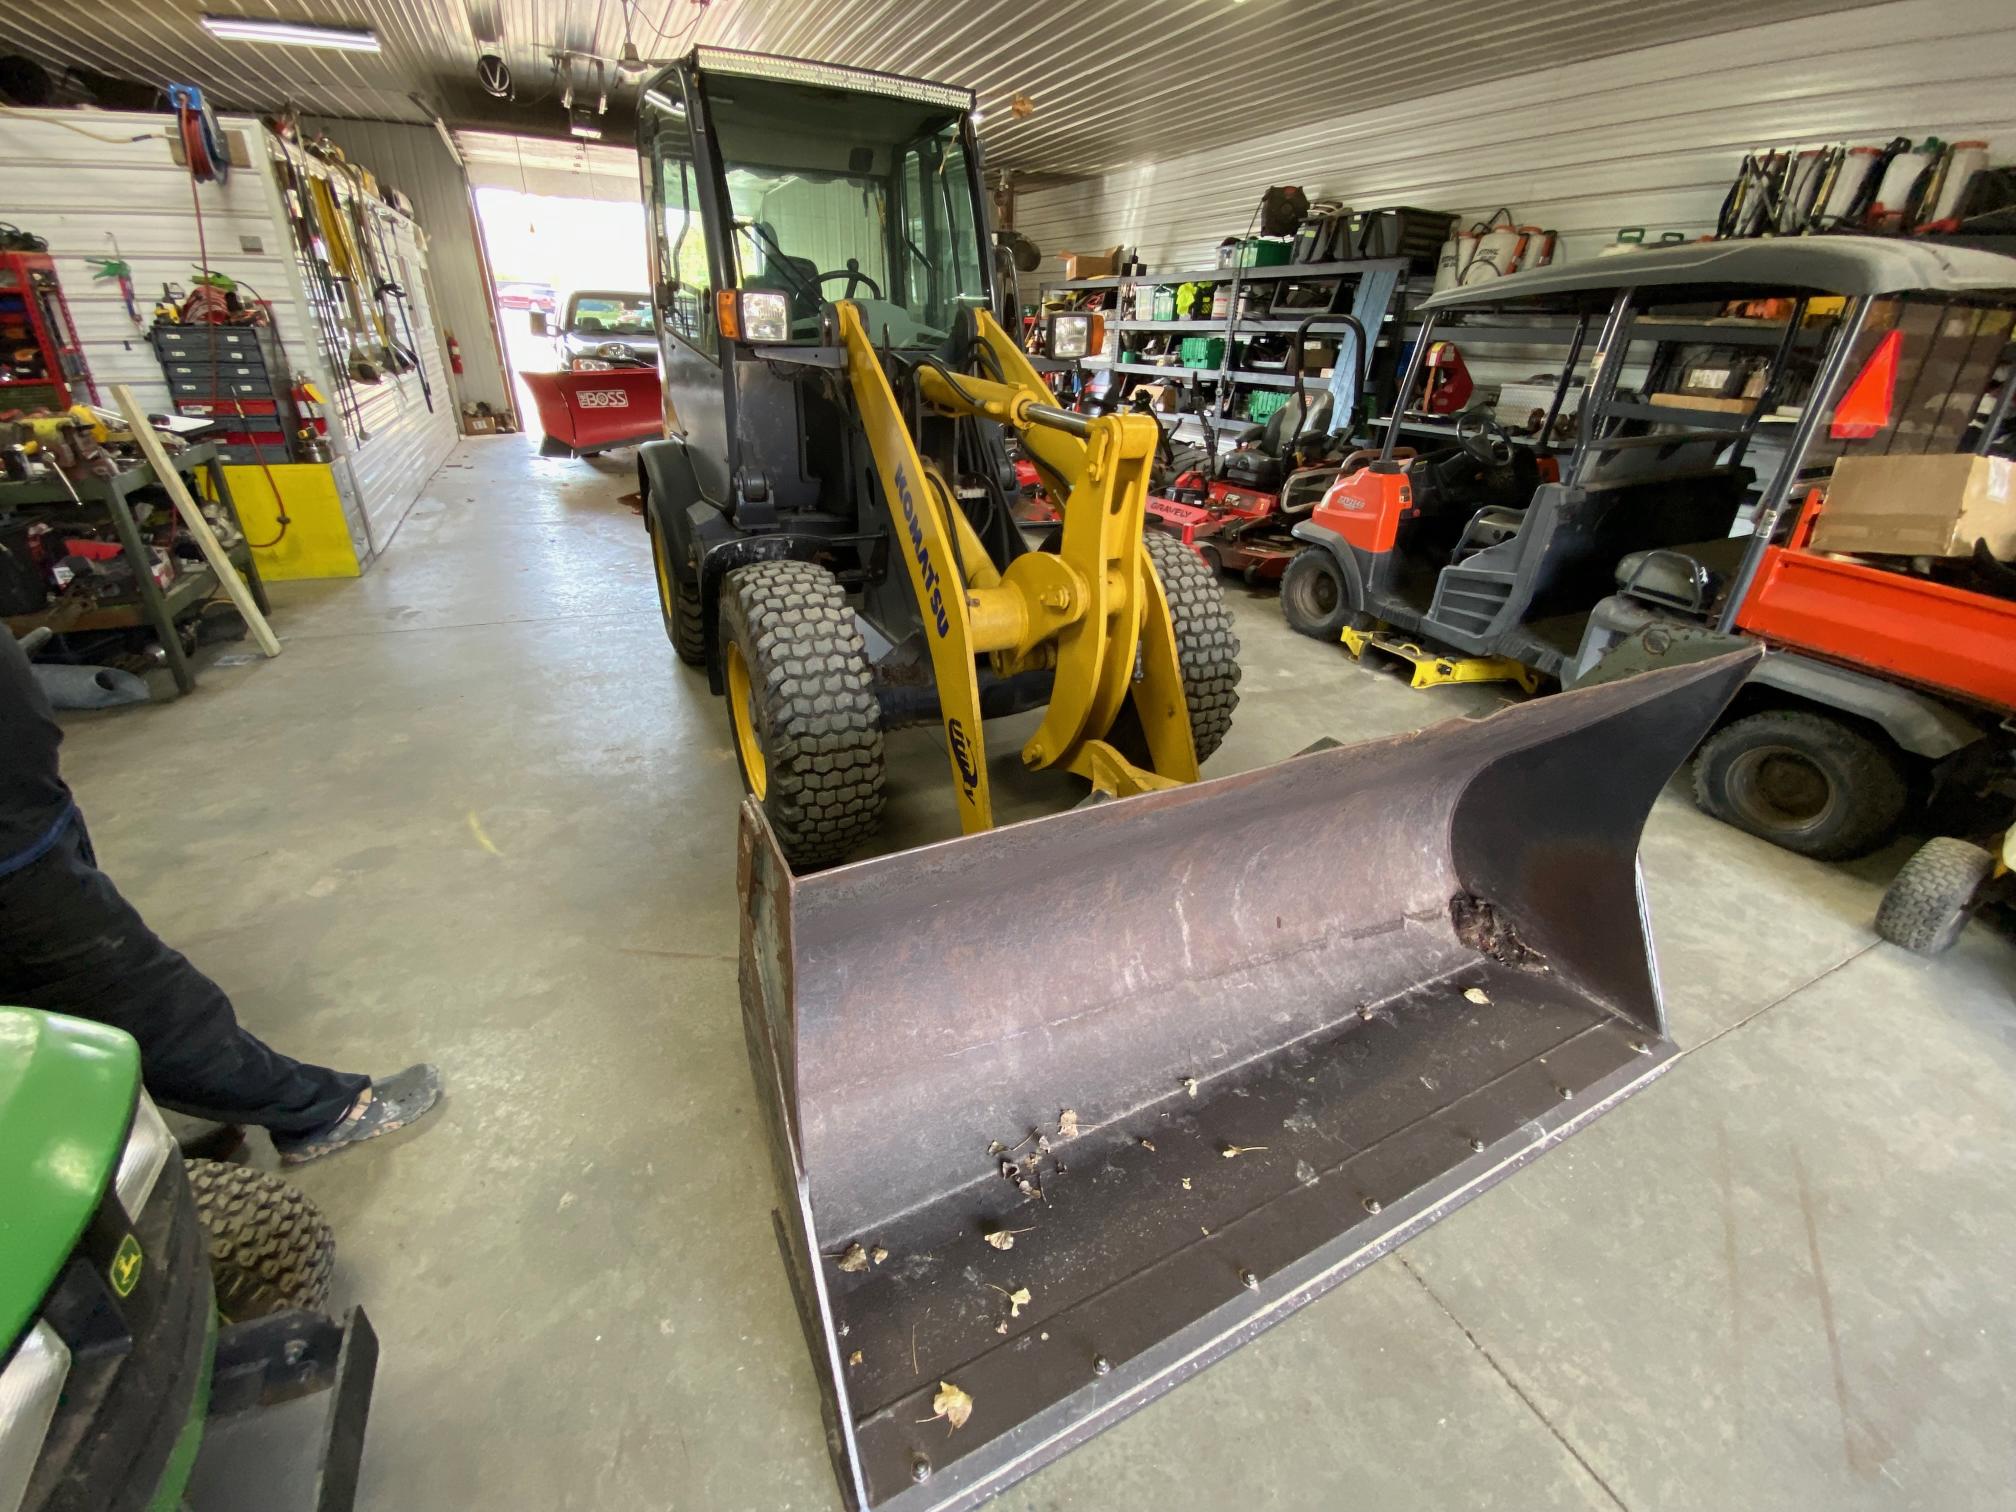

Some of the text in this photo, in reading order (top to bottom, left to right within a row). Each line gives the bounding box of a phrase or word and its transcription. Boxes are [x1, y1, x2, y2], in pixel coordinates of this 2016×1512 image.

[587, 391, 627, 406] BOSS
[1150, 501, 1192, 518] GRAVELY
[895, 463, 949, 639] KOMATSU
